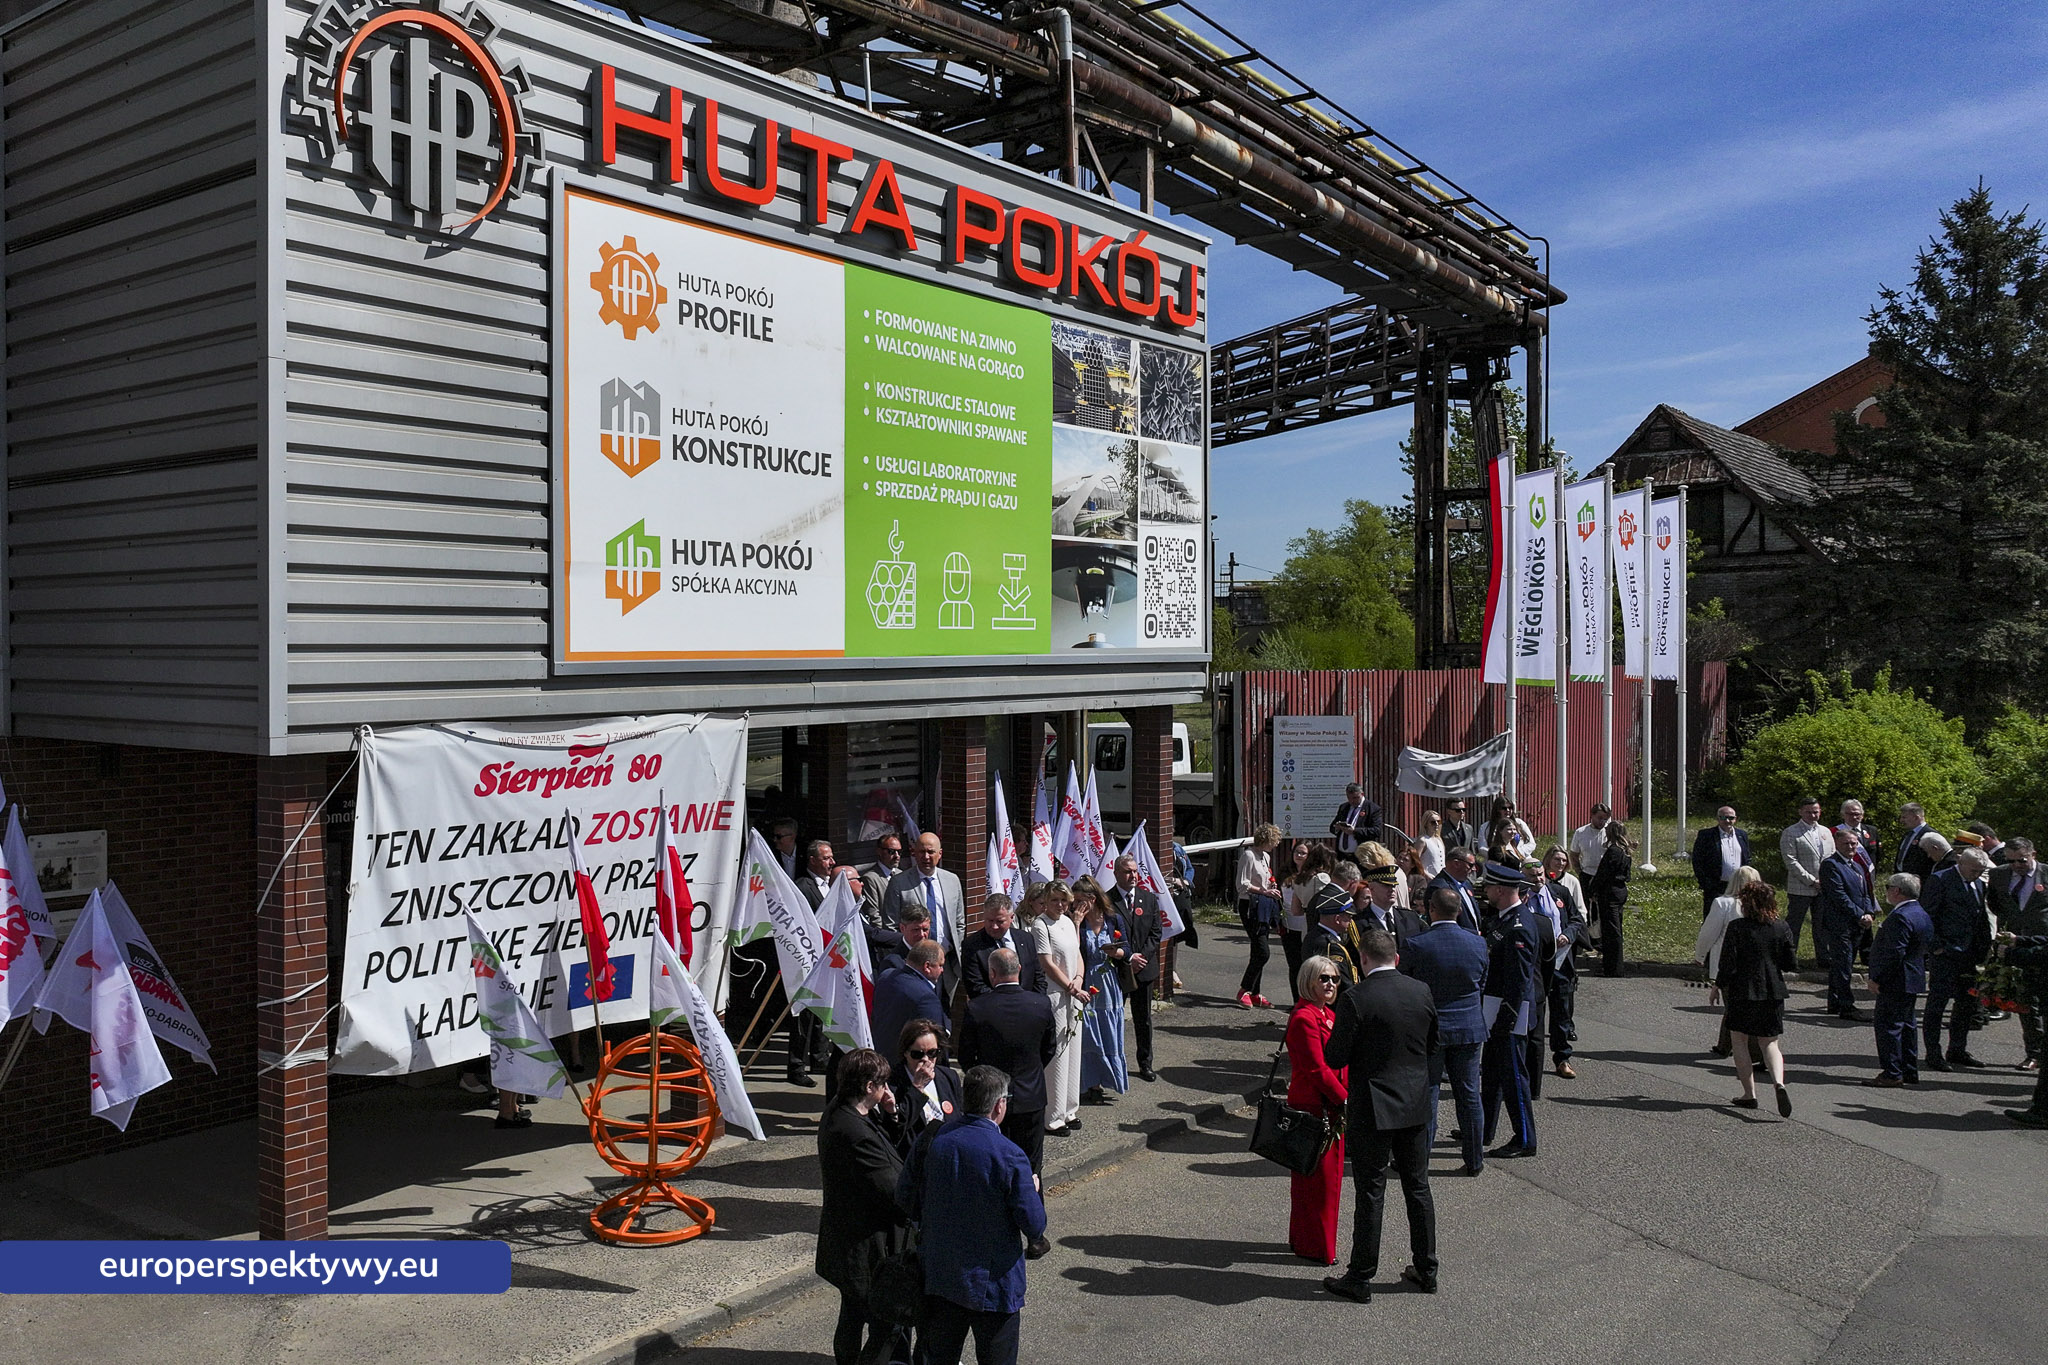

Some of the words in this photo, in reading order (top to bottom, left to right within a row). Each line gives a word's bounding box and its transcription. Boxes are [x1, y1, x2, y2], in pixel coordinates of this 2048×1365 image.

[601, 64, 918, 251] HUTA
[956, 184, 1198, 327] POKÓJ
[678, 272, 721, 297] HUTA
[725, 282, 774, 309] POKÓJ
[678, 298, 774, 343] PROFILE
[875, 309, 958, 343] FORMOWANE
[960, 328, 978, 347] NA
[978, 333, 1017, 356] ZIMNO
[875, 334, 957, 366] WALCOWANE
[959, 352, 976, 371] NA
[977, 356, 1024, 381] GORĄCO
[672, 407, 716, 430] HUTA
[720, 414, 769, 437] POKÓJ
[876, 381, 962, 412] KONSTRUKCJE
[964, 398, 1016, 421] STALOWE
[876, 407, 973, 437] KSZTAŁTOWNIKI
[975, 422, 1028, 446] SPAWANE
[672, 434, 832, 478] KONSTRUKCJE
[875, 455, 921, 476] USŁUGI
[923, 461, 1017, 488] LABORATORYJNE
[875, 480, 938, 503] SPRZEDAŻ
[940, 487, 980, 509] PRĄDU
[982, 493, 986, 507] I
[988, 493, 1018, 511] GAZU
[672, 538, 737, 568] HUTA
[742, 540, 813, 571] POKÓJ
[671, 572, 732, 594] SPÓŁKA
[734, 577, 798, 596] AKCYJNA
[1520, 536, 1546, 657] WĘGLOKOKS
[1579, 556, 1589, 608] POKÓJ
[1628, 561, 1640, 628] PROFILE
[1659, 557, 1671, 656] KONSTRUKCJE
[1584, 612, 1592, 656] HUTA
[498, 735, 530, 746] WOLNY
[530, 734, 566, 746] ZWIĄZEK
[474, 754, 615, 799] Sierpień
[627, 753, 663, 783] 80
[367, 828, 437, 873] TEN
[438, 815, 581, 862] ZAKŁAD
[604, 853, 699, 895] PRZZ
[363, 925, 528, 990] POLITKĘ
[530, 901, 713, 957] ZIEONEO
